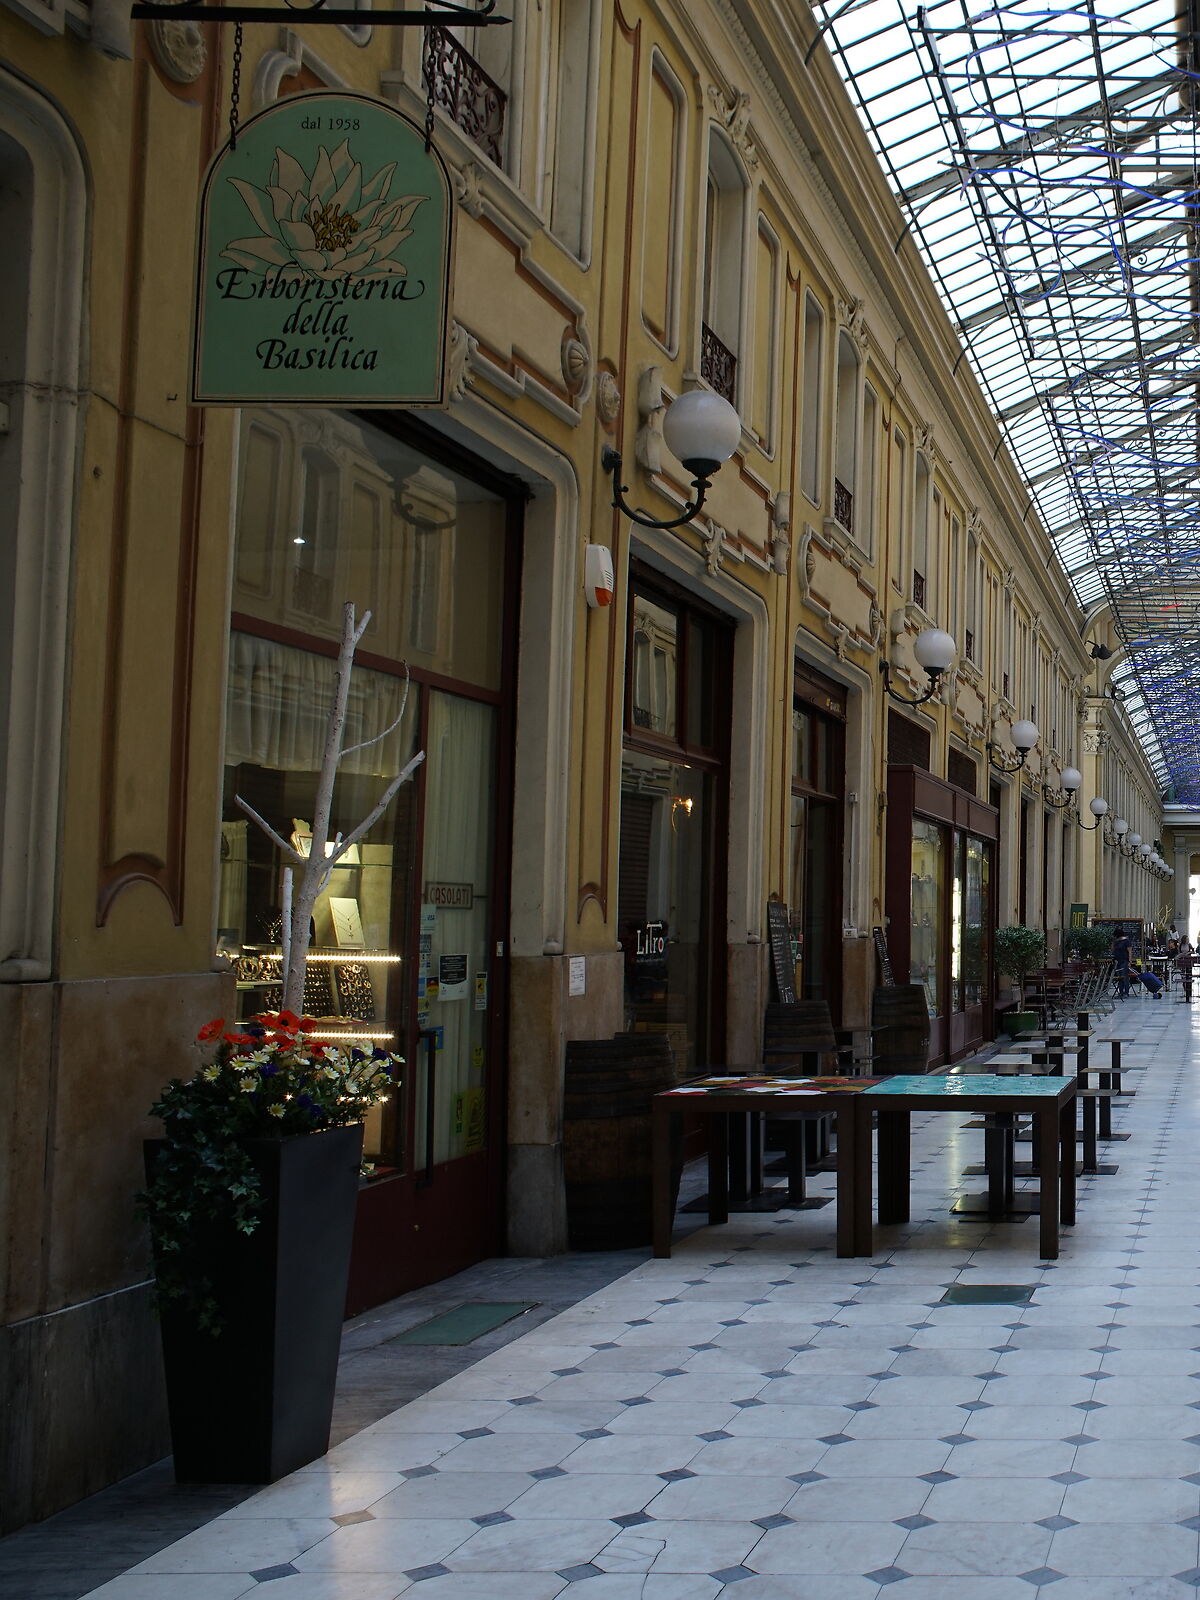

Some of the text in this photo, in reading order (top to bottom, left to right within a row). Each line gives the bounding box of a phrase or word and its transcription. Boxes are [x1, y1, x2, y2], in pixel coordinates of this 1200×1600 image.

[301, 116, 360, 131] dal 1958
[216, 261, 425, 300] Erboristeria
[282, 298, 349, 336] della
[255, 336, 378, 371] Basilica
[430, 887, 469, 905] CASOLATI
